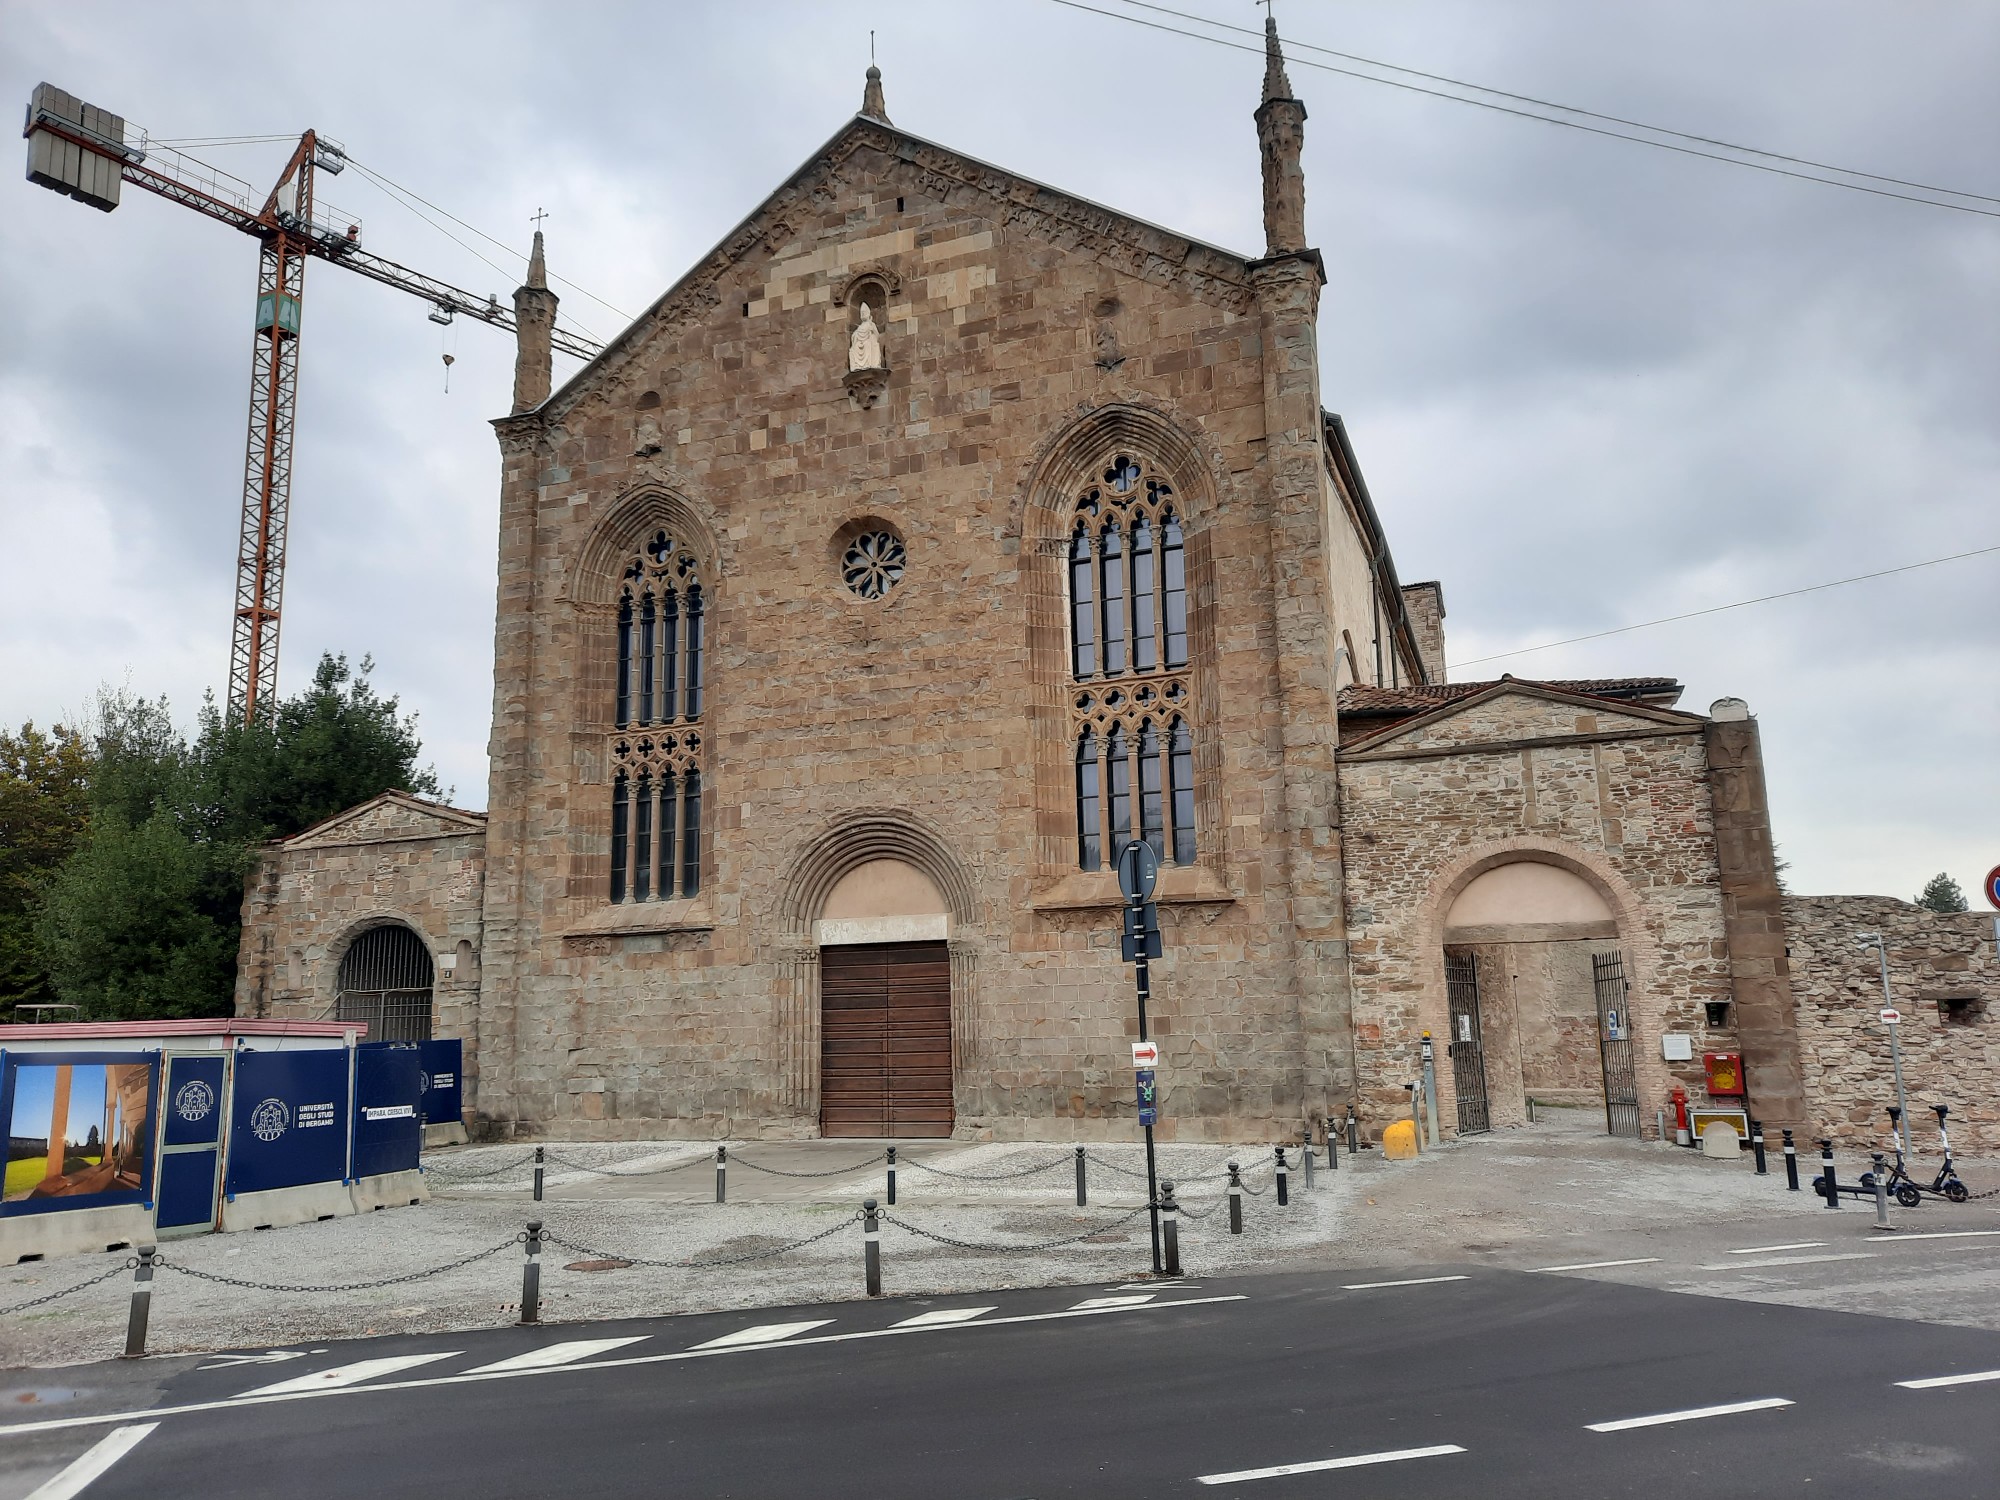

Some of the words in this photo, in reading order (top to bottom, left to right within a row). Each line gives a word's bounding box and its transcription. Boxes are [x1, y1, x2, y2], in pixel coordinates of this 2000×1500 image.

[299, 1102, 334, 1111] UNIVERSITÀ
[299, 1112, 316, 1120] DEGLI
[317, 1111, 334, 1119] STUDI
[298, 1121, 306, 1129] DI
[305, 1119, 334, 1127] BERGAMO
